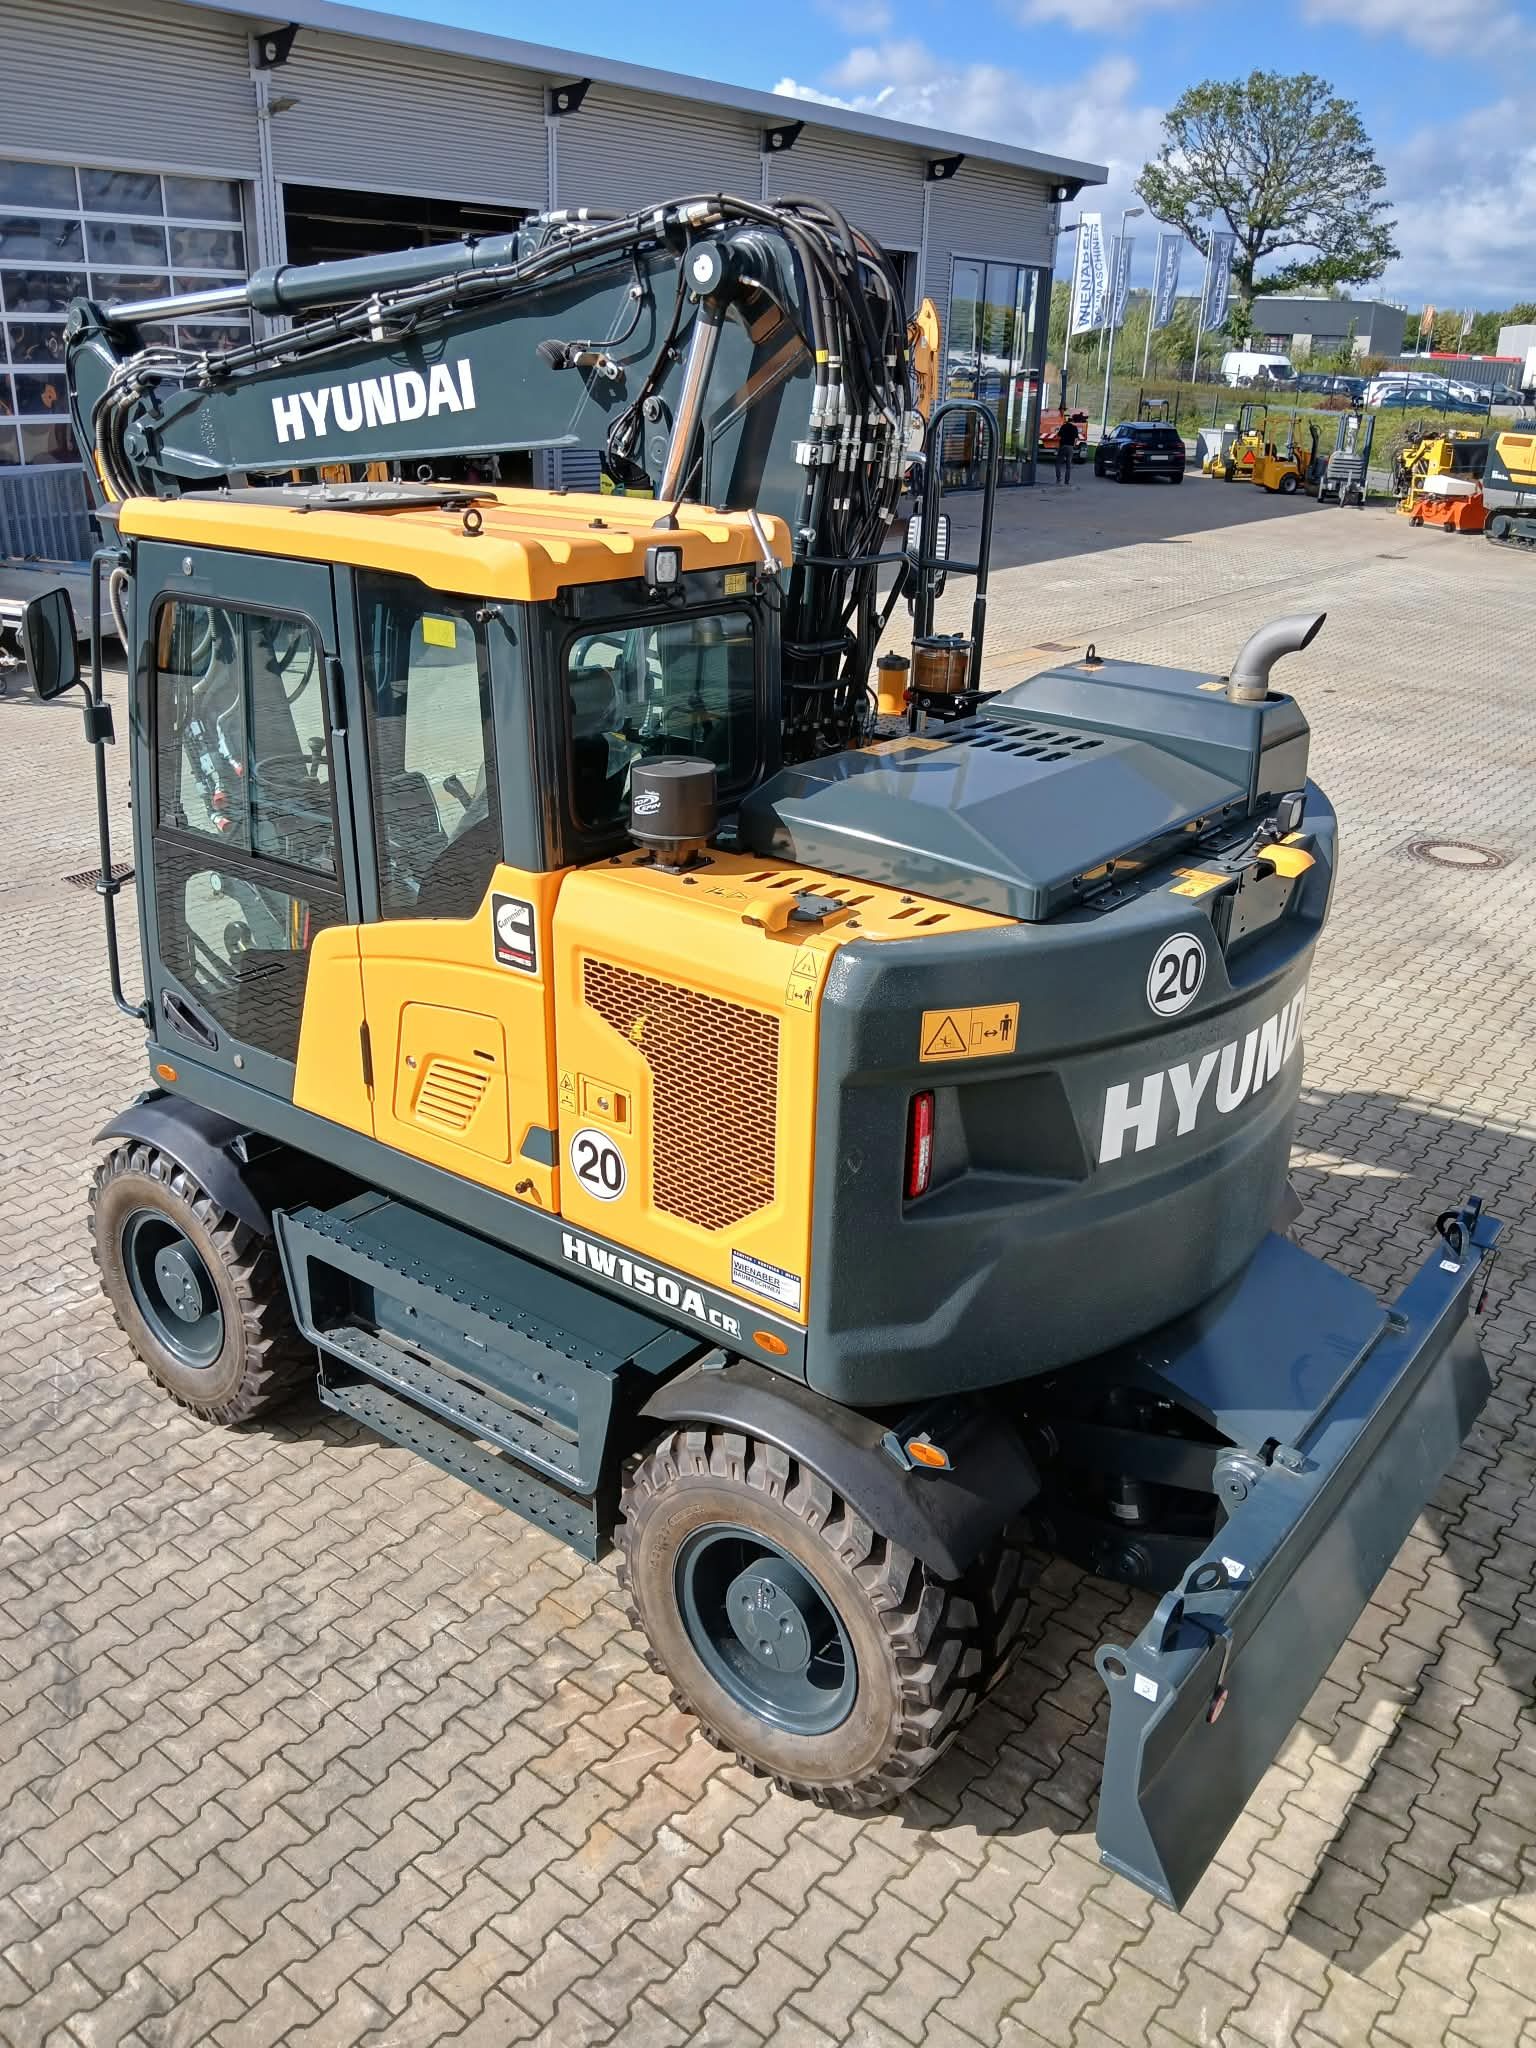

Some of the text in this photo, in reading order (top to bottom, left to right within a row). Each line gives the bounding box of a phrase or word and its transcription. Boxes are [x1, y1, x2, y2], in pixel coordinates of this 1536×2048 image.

[272, 358, 476, 443] HYUNDAI
[498, 908, 526, 929] Cummins
[1154, 948, 1202, 1004] 20
[578, 1139, 622, 1191] 20
[733, 1260, 780, 1286] WIENABER
